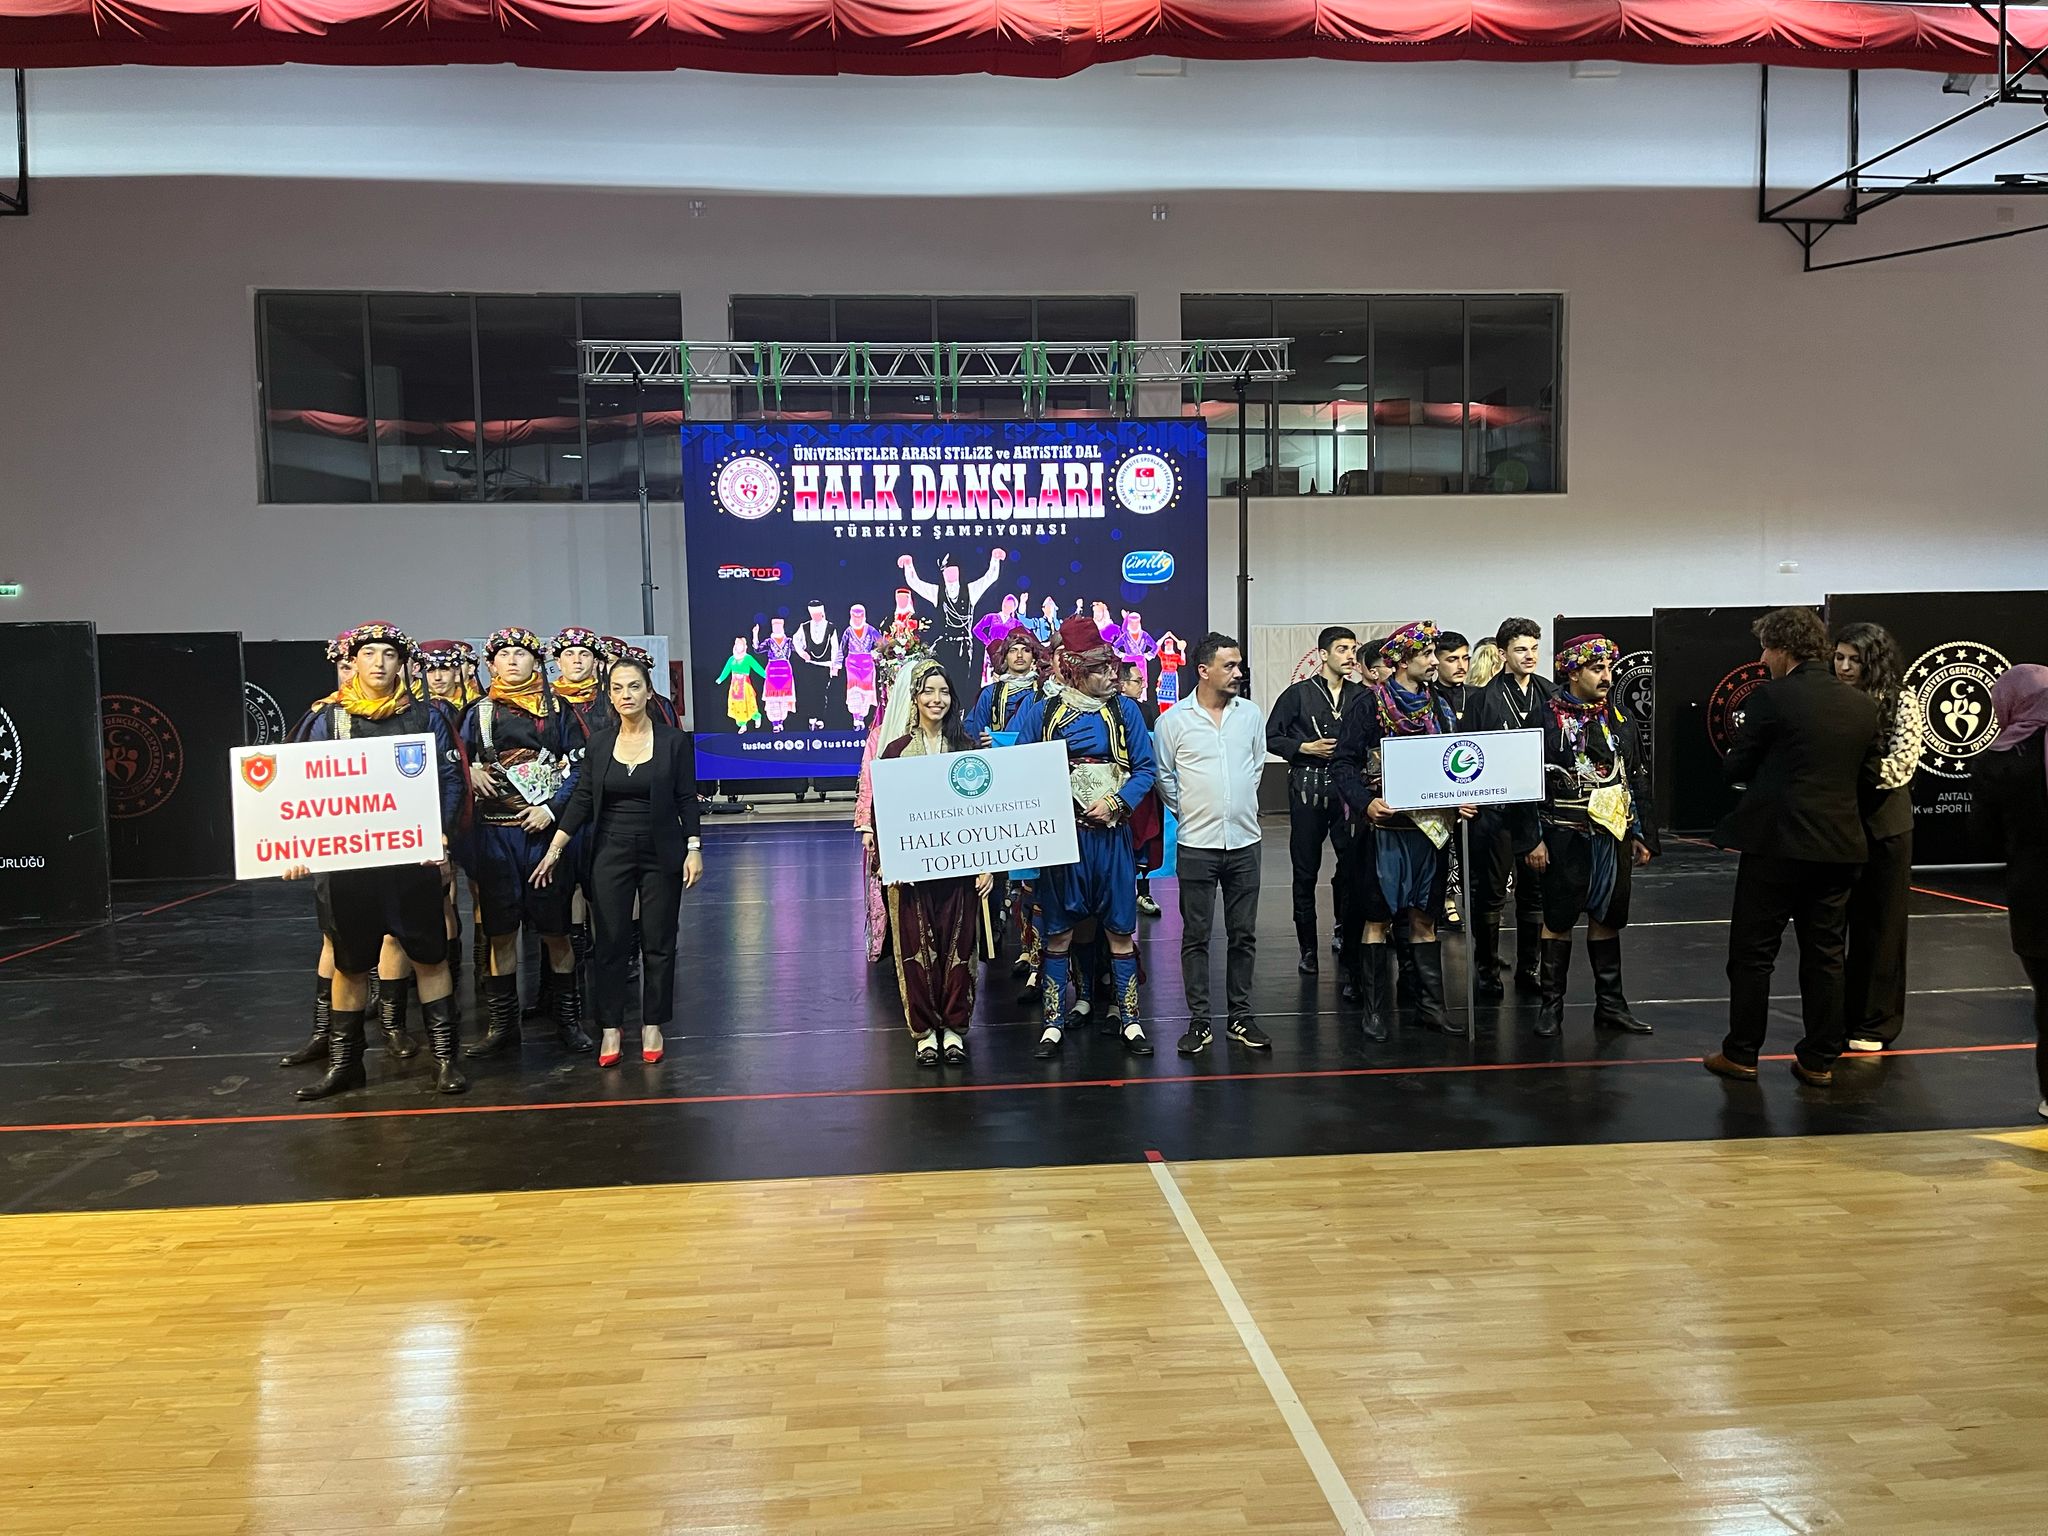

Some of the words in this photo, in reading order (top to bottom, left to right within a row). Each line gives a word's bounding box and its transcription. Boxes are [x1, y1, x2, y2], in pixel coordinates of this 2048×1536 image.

[901, 447, 941, 460] ARASI
[996, 450, 1010, 459] ve
[1075, 445, 1101, 458] DAL
[791, 464, 902, 521] HALK
[911, 462, 1105, 520] DANSLARI
[834, 523, 921, 537] TÜRKİYE
[1949, 666, 1986, 680] GENÇLİK
[1984, 677, 1996, 689] VE
[1970, 714, 1999, 752] AKANLIĞI
[305, 752, 367, 780] MİLLİ
[280, 792, 397, 820] SAVUNMA
[1420, 790, 1455, 800] GİRESUN
[1457, 787, 1508, 798] ÜNİVERSİTESİ
[909, 807, 964, 822] BALIKESİR
[967, 799, 1041, 816] ÜNİVERSİTESİ
[1935, 804, 1962, 814] SPOR
[256, 824, 423, 862] ÜNİVERSİTESİ
[900, 831, 953, 851] HALK
[957, 819, 1056, 844] OYUNLARI
[922, 844, 1039, 872] TOPLULUĞU
